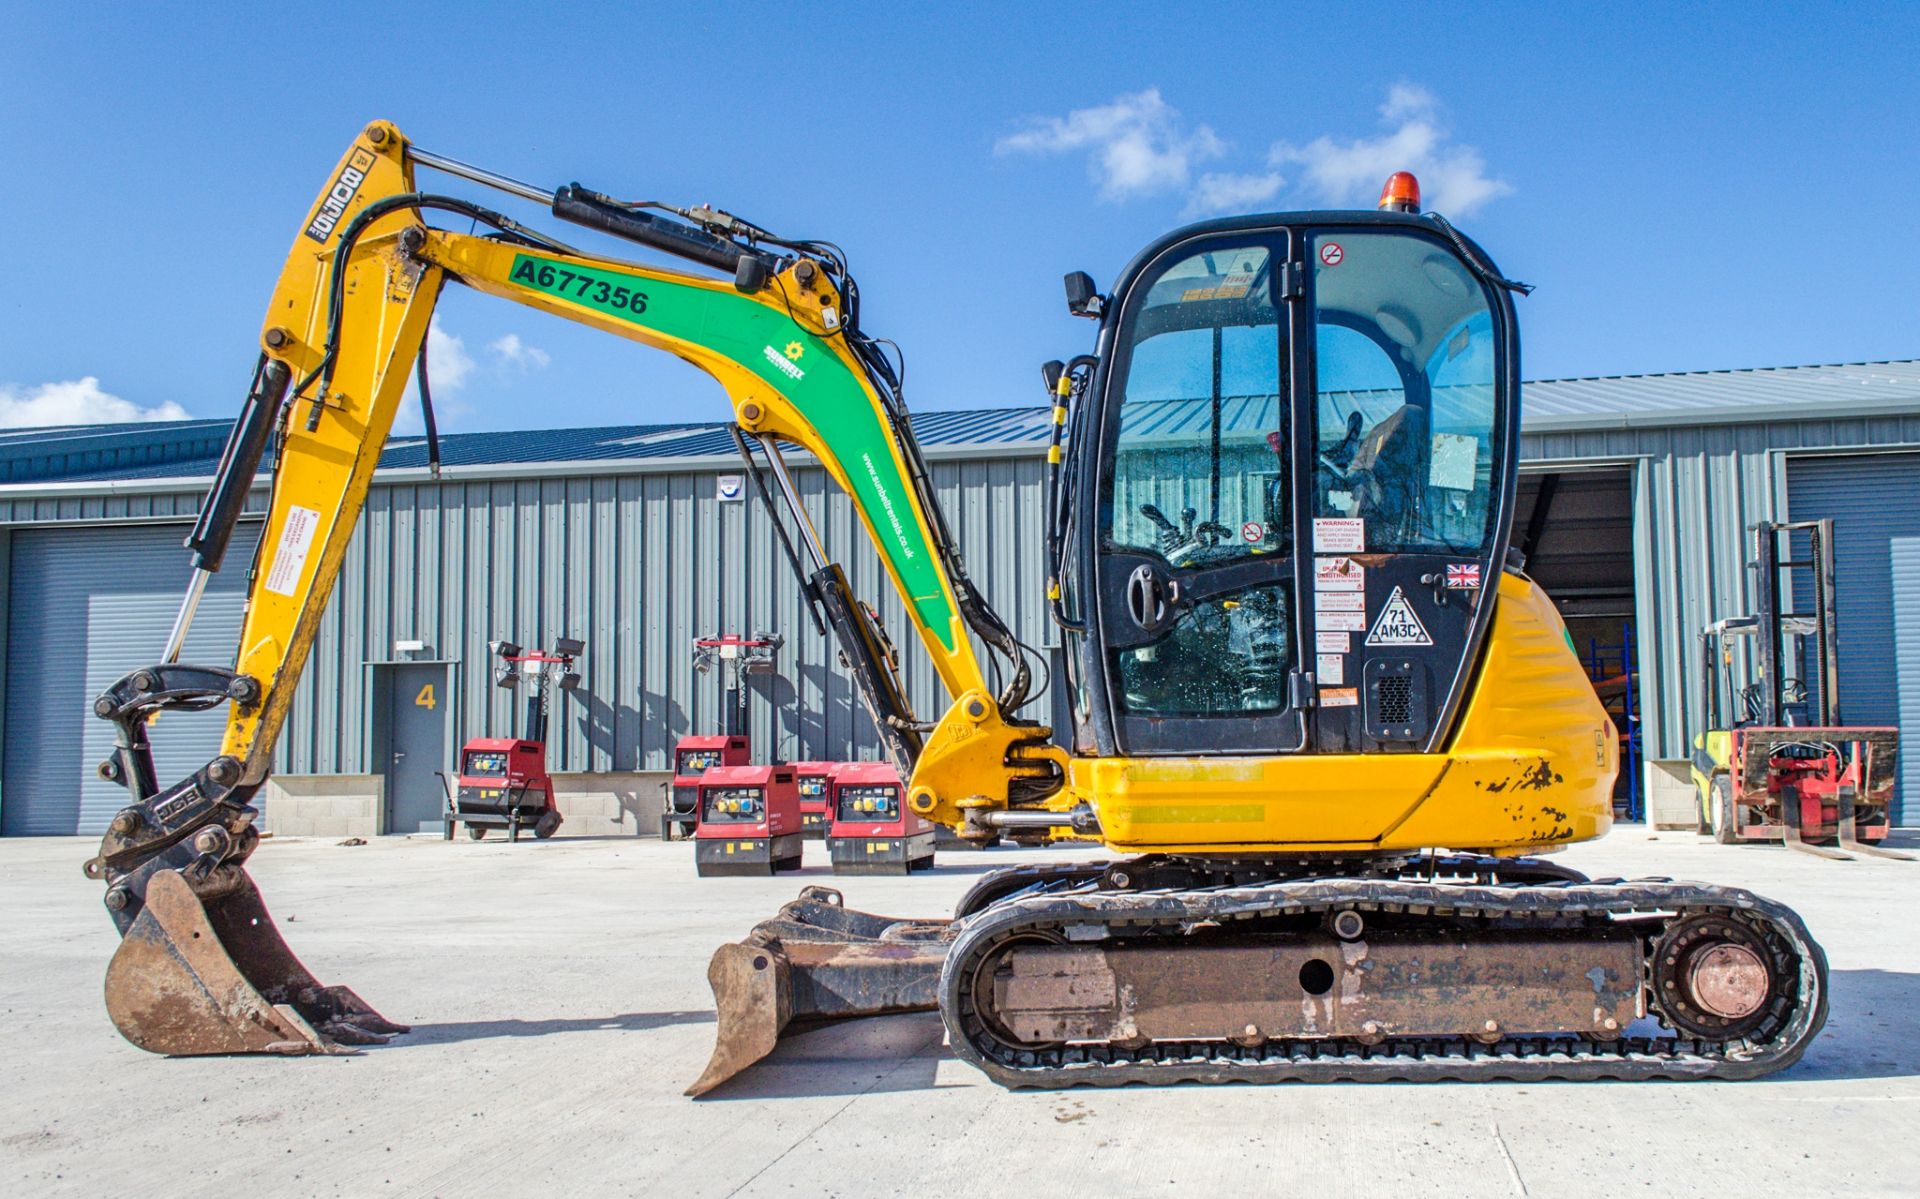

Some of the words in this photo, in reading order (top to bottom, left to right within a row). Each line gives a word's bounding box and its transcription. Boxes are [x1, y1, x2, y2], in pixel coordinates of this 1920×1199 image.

[313, 167, 364, 233] 8055
[514, 259, 649, 314] A677356
[763, 344, 805, 381] SUNBELT
[861, 452, 915, 560] www.sunbeltrentals.co.uk
[1380, 624, 1417, 638] AM3C
[1390, 609, 1406, 623] 71
[415, 684, 436, 710] 4
[157, 788, 199, 819] JCB
